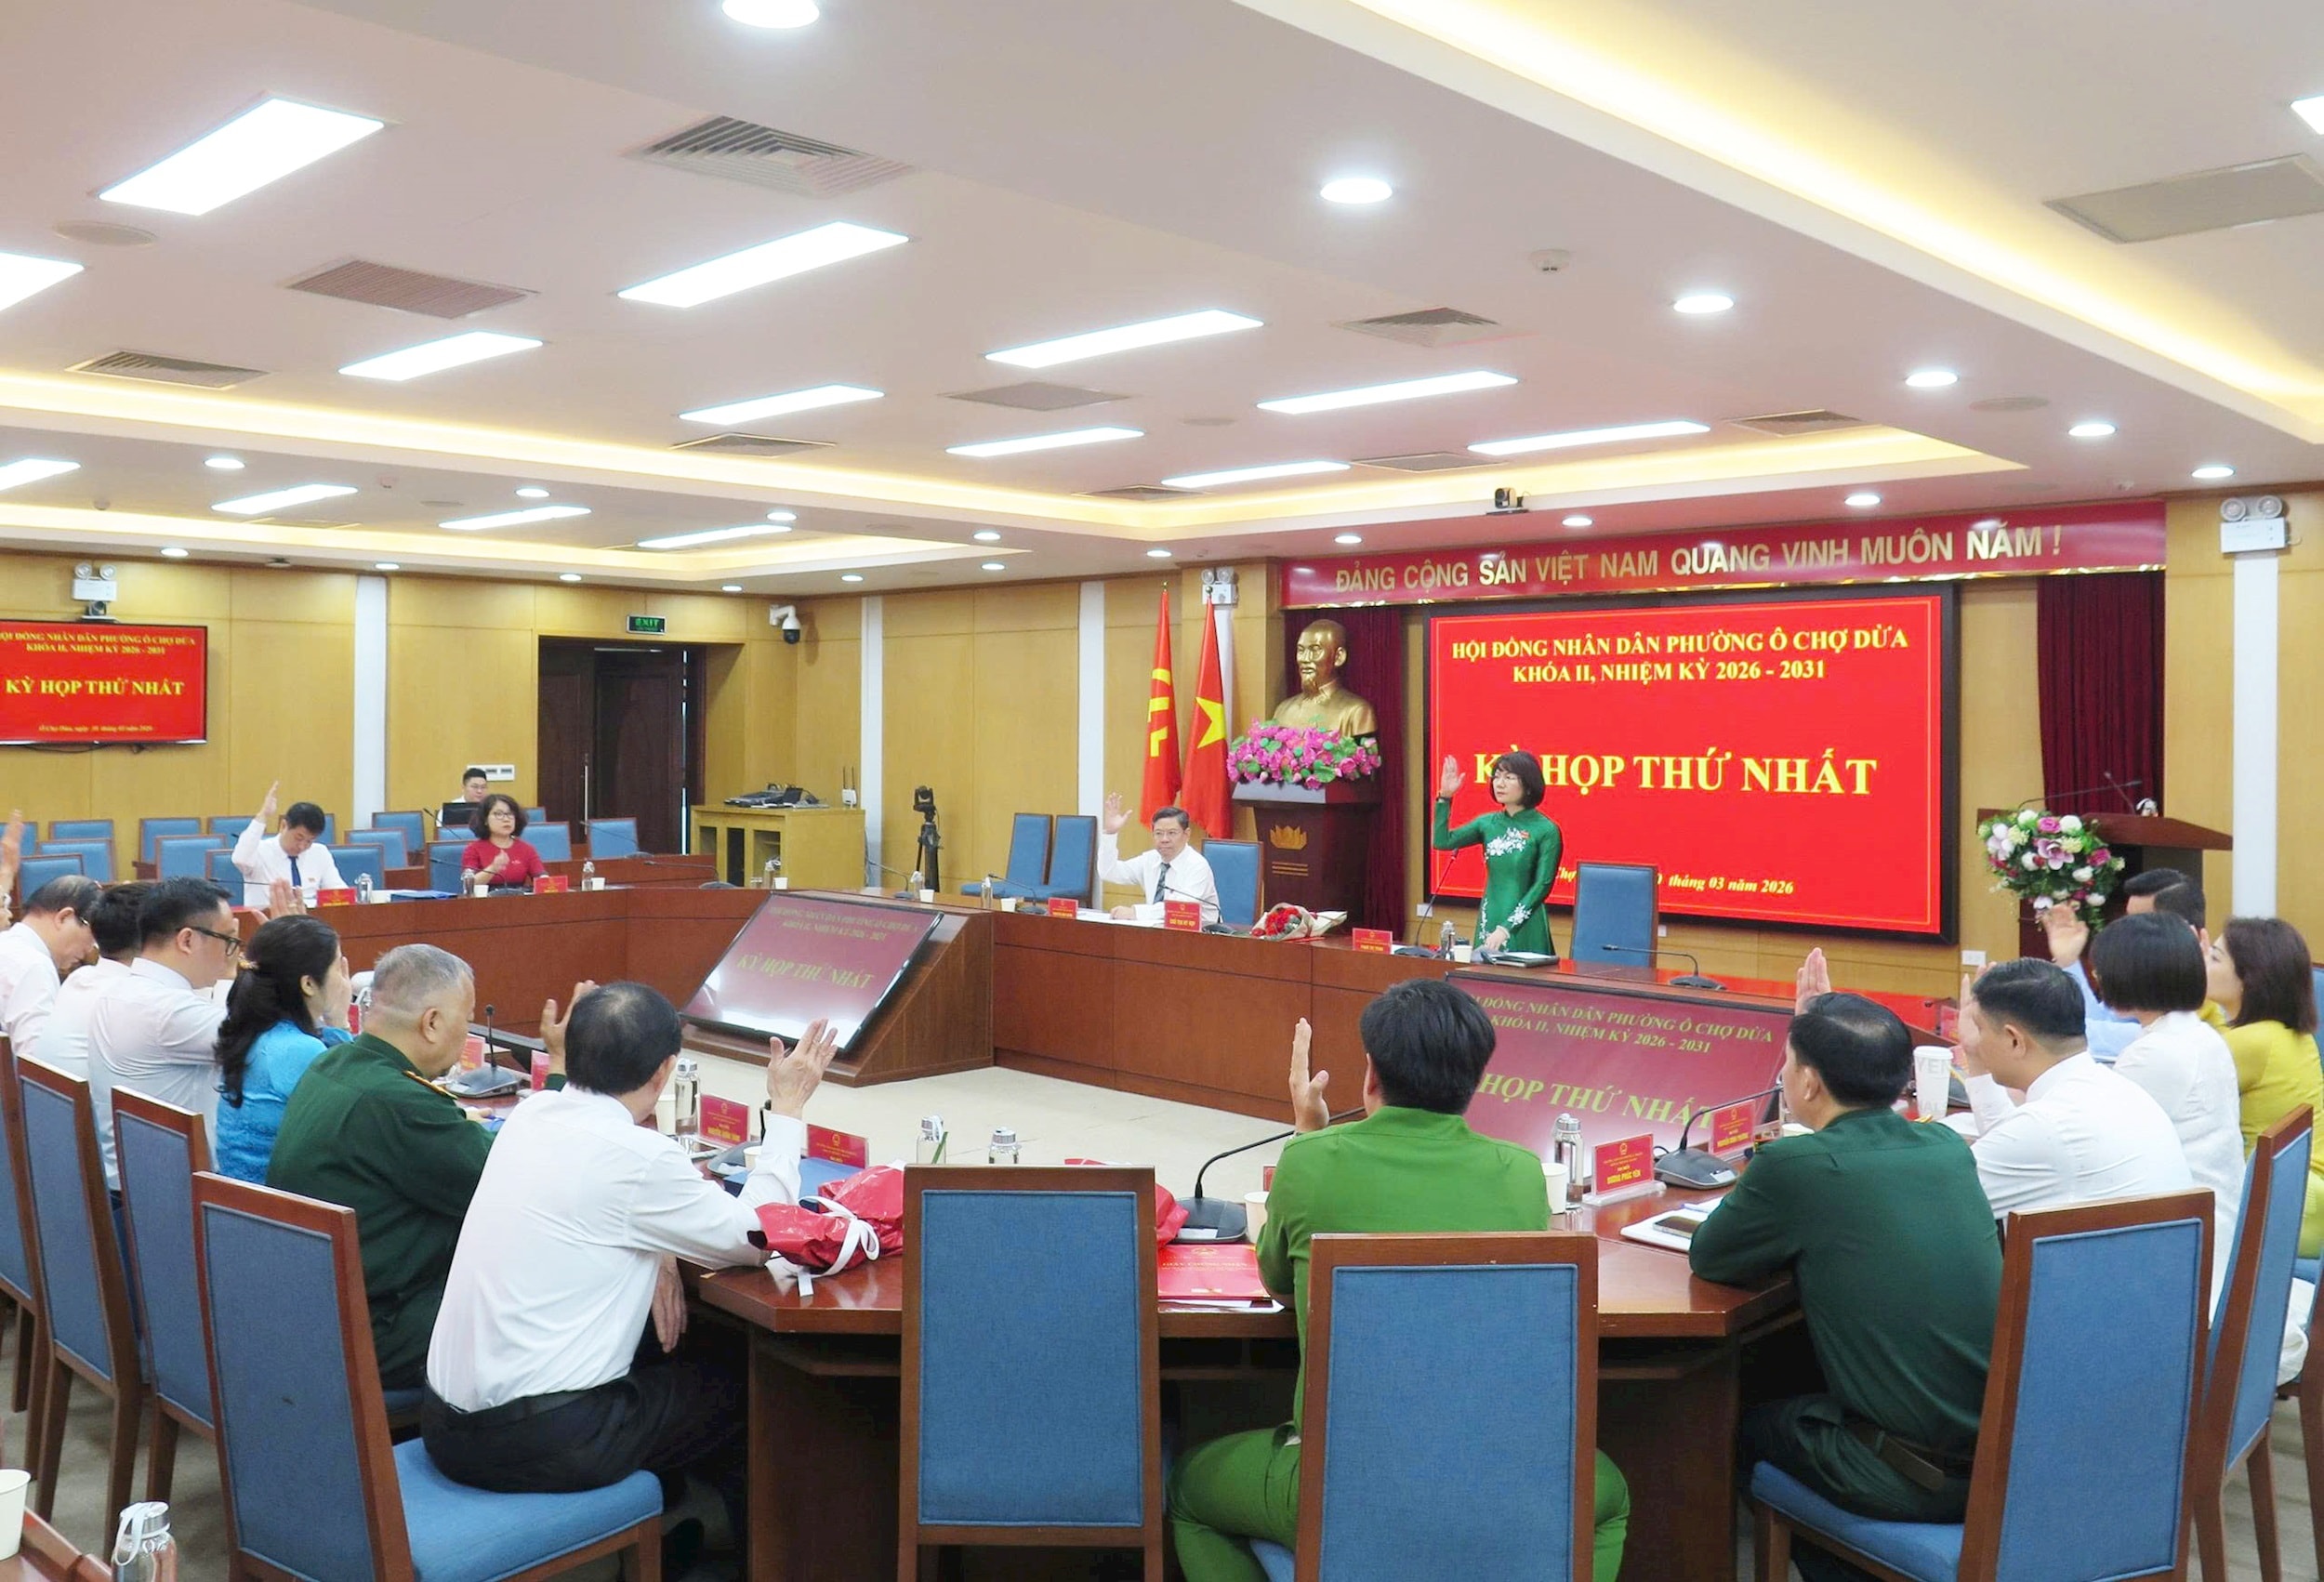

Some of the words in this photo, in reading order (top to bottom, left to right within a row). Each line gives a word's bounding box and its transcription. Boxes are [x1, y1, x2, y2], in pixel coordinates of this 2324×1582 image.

[1336, 560, 1395, 592] ĐẢNG
[1404, 560, 1469, 593] CỘNG
[1479, 551, 1527, 587] SẢN
[1536, 549, 1590, 587] VIỆT
[1600, 550, 1659, 578] NAM
[1671, 544, 1770, 576] QUANG
[1781, 538, 1850, 570] VINH
[1860, 527, 1954, 565] MUÔN
[1967, 521, 2042, 560] NĂM
[2052, 525, 2062, 555] !
[1452, 639, 1487, 663] HỘI
[1491, 636, 1549, 659] ĐỒNG
[1553, 633, 1611, 656] NHÂN
[1616, 631, 1661, 654] DÂN
[1667, 629, 1764, 653] PHƯỜNG
[1769, 626, 1789, 651] Ô
[1793, 627, 1849, 654] CHỢ
[1854, 624, 1909, 649] DỪA
[6, 675, 34, 694] KỲ
[40, 679, 83, 698] HỌP
[86, 676, 130, 695] THỨ
[132, 677, 186, 696] NHẤT
[1512, 661, 1571, 683] KHÓA
[1576, 665, 1597, 684] II,
[1601, 662, 1672, 685] NHIỆM
[1679, 657, 1710, 680] KỲ
[1716, 661, 1762, 680] 2026
[1779, 659, 1825, 679] 2031
[1539, 754, 1626, 796] HỌP
[1633, 746, 1733, 792] THỨ
[1742, 747, 1879, 795] NHẤT
[1668, 874, 1706, 891] tháng
[1709, 877, 1724, 890] 03
[1727, 877, 1758, 892] năm
[1761, 879, 1794, 895] 2026
[1490, 1014, 1532, 1031] KHÓA
[1555, 1022, 1604, 1041] NHIỆM
[1608, 1028, 1633, 1043] KỲ
[1634, 1033, 1667, 1048] 2026
[1678, 1038, 1711, 1053] 2031
[1525, 1001, 1568, 1018] NHÂN
[1571, 1006, 1604, 1022] DÂN
[1606, 1011, 1676, 1032] PHƯỜNG
[1678, 1017, 1693, 1033] Ô
[1695, 1022, 1736, 1039] CHỢ
[1736, 1025, 1774, 1042] DỪA
[1476, 1074, 1545, 1103] HỌP
[1548, 1082, 1623, 1114] THỨ
[1622, 1095, 1712, 1129] NHẤT
